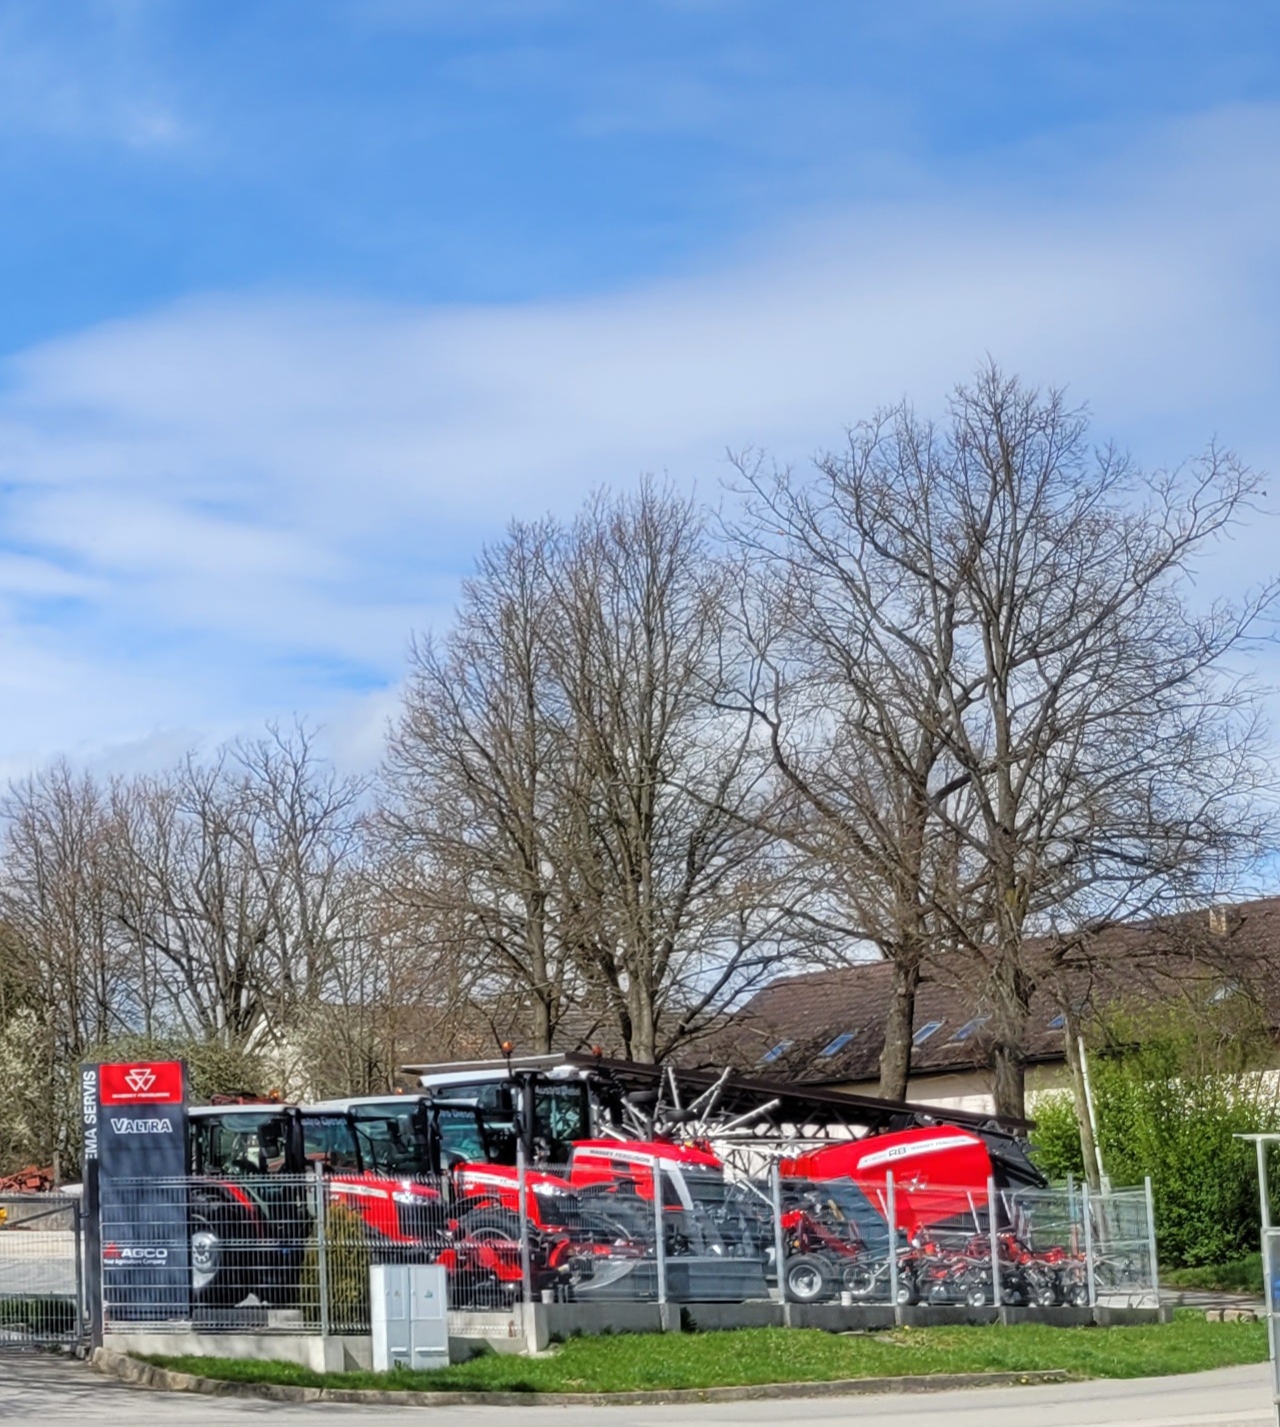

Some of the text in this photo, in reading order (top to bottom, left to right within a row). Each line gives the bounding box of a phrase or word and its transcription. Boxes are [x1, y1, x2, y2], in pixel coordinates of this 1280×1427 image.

[82, 1070, 98, 1170] EMA SERVIS
[110, 1118, 173, 1134] VALTRA
[121, 1248, 168, 1258] AGCO
